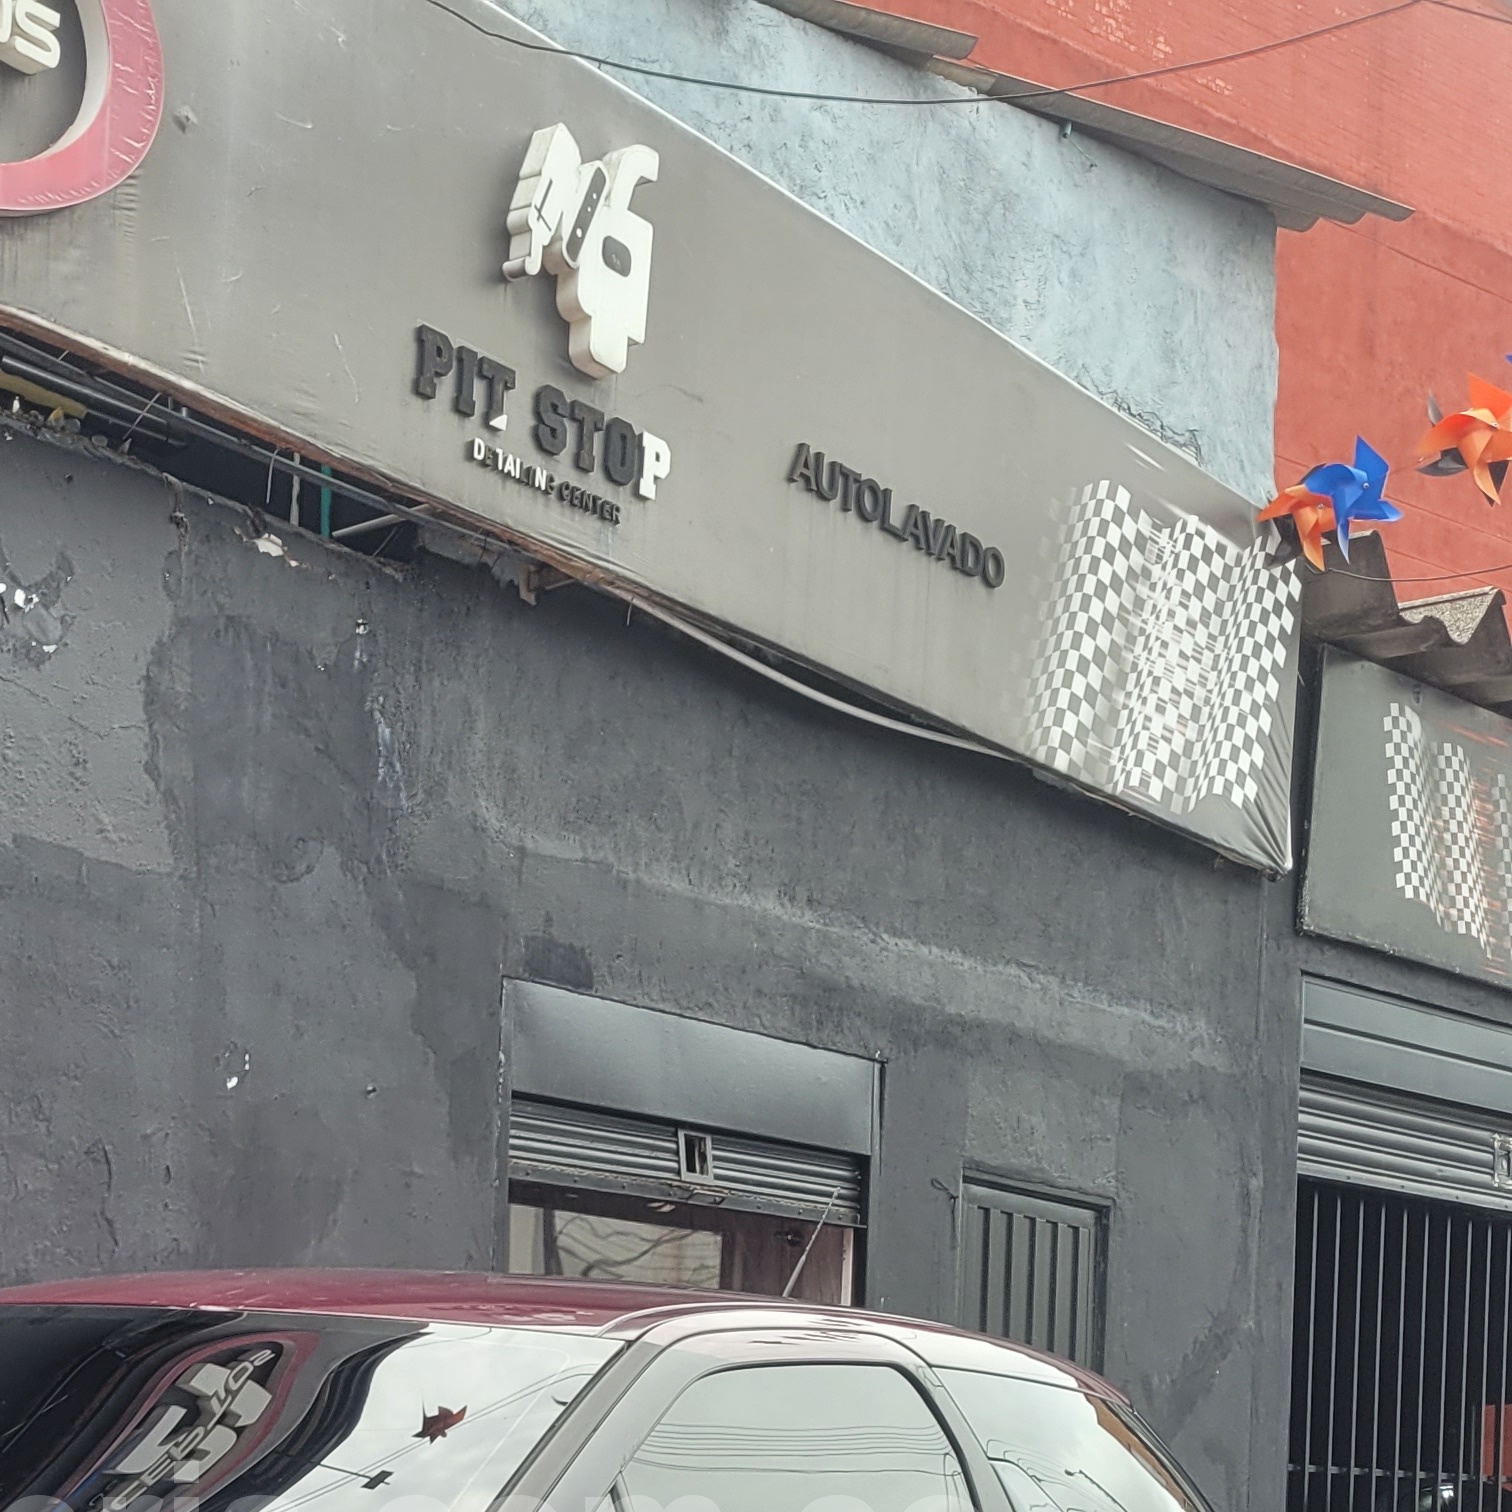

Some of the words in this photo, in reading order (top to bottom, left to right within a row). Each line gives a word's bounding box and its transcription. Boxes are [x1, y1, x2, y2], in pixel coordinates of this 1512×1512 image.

[414, 323, 517, 431] PIT
[534, 383, 672, 501] STOP
[559, 480, 622, 525] CENTER
[788, 441, 1005, 588] AUTOLAVADO
